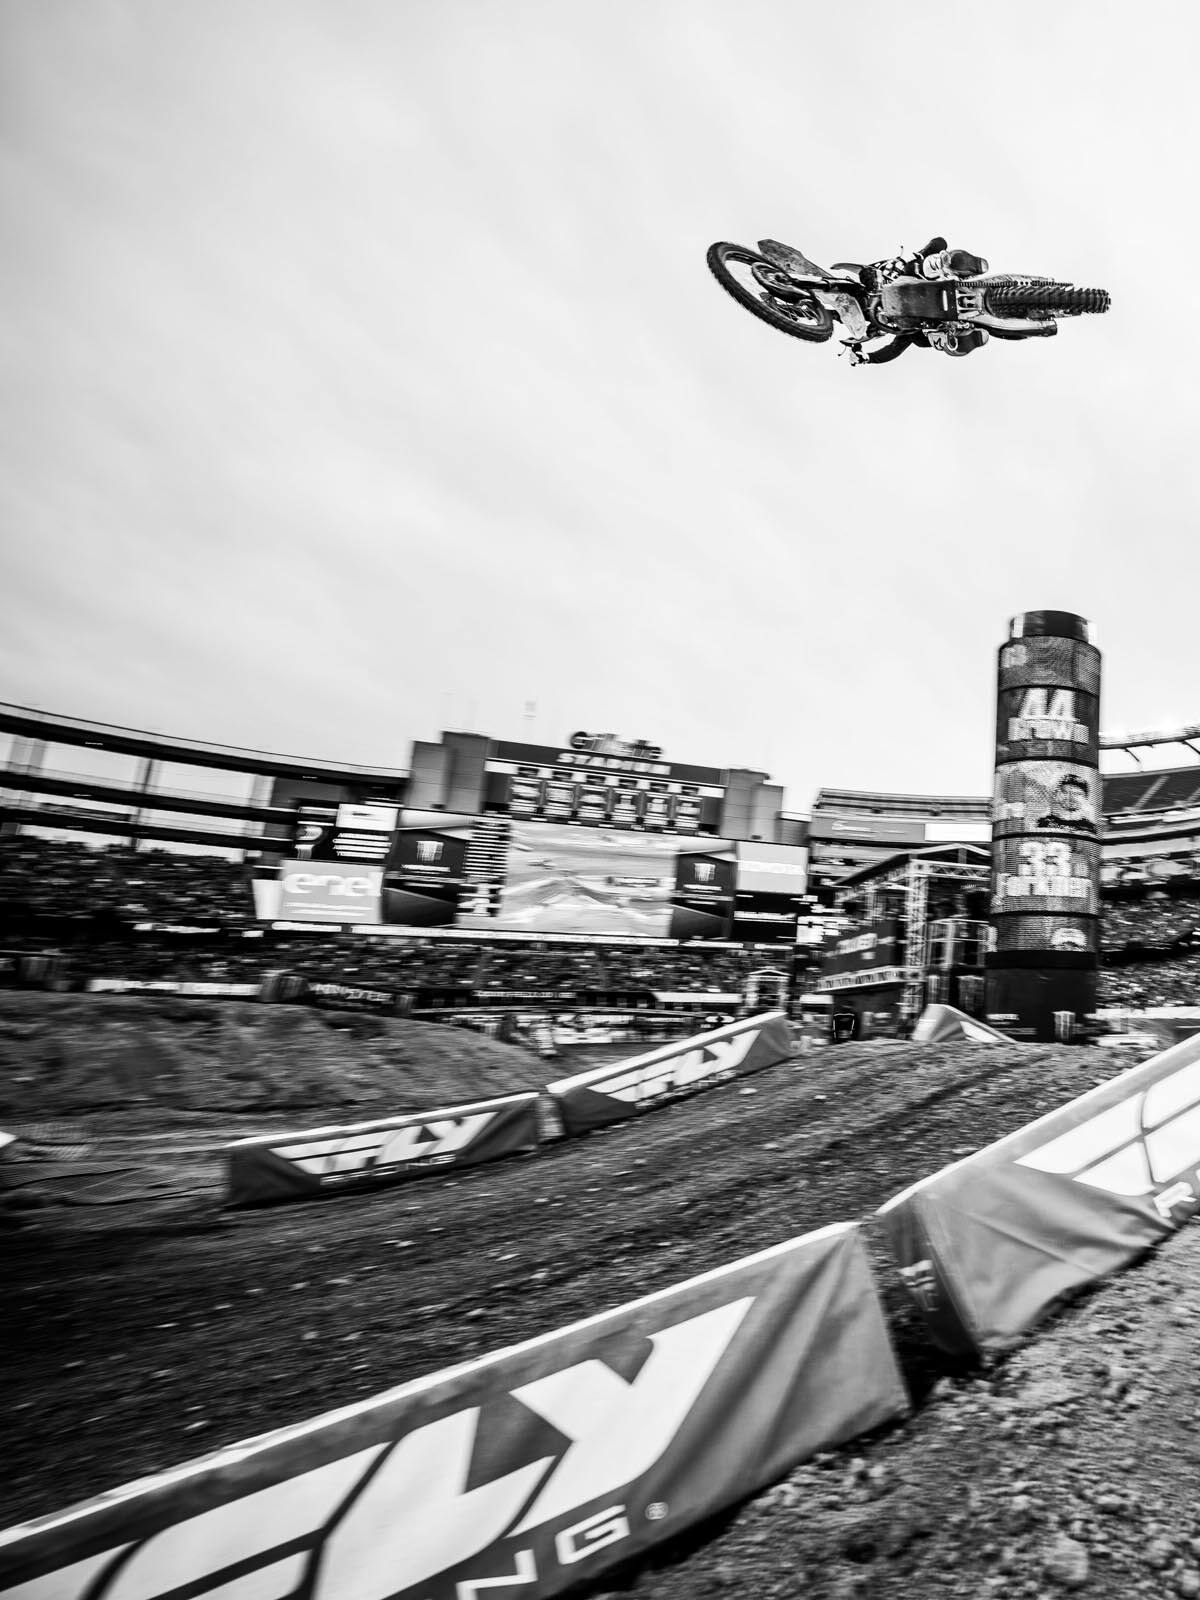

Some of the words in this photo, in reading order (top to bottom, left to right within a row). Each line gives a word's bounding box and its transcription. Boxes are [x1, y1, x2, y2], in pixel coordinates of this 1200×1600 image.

[283, 872, 384, 898] enel
[585, 1029, 762, 1102] FLY
[269, 1112, 497, 1175] FLY
